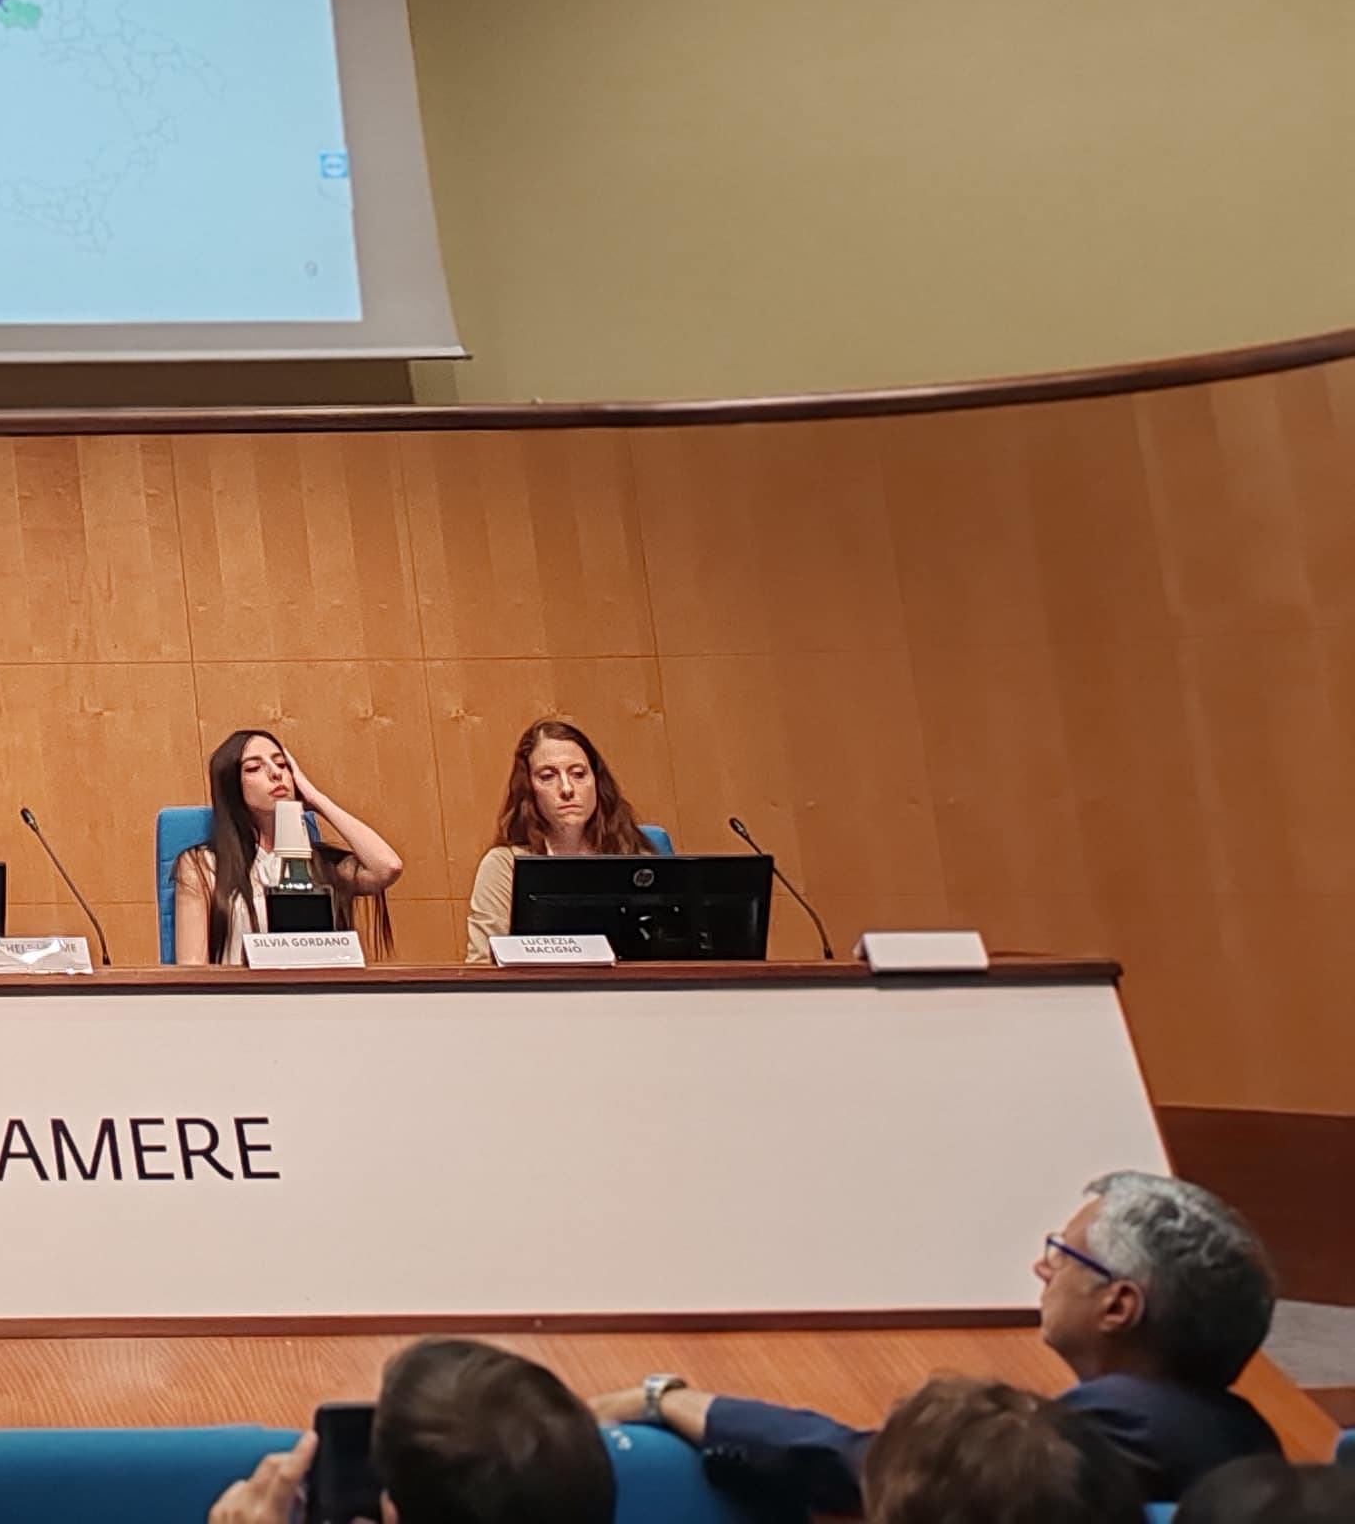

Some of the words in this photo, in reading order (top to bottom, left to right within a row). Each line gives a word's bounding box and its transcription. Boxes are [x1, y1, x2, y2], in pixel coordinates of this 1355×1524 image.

[253, 938, 289, 948] SILVIA
[291, 937, 350, 947] GORDANO
[520, 937, 577, 946] LUCREZIA
[525, 946, 582, 954] MACIGNO
